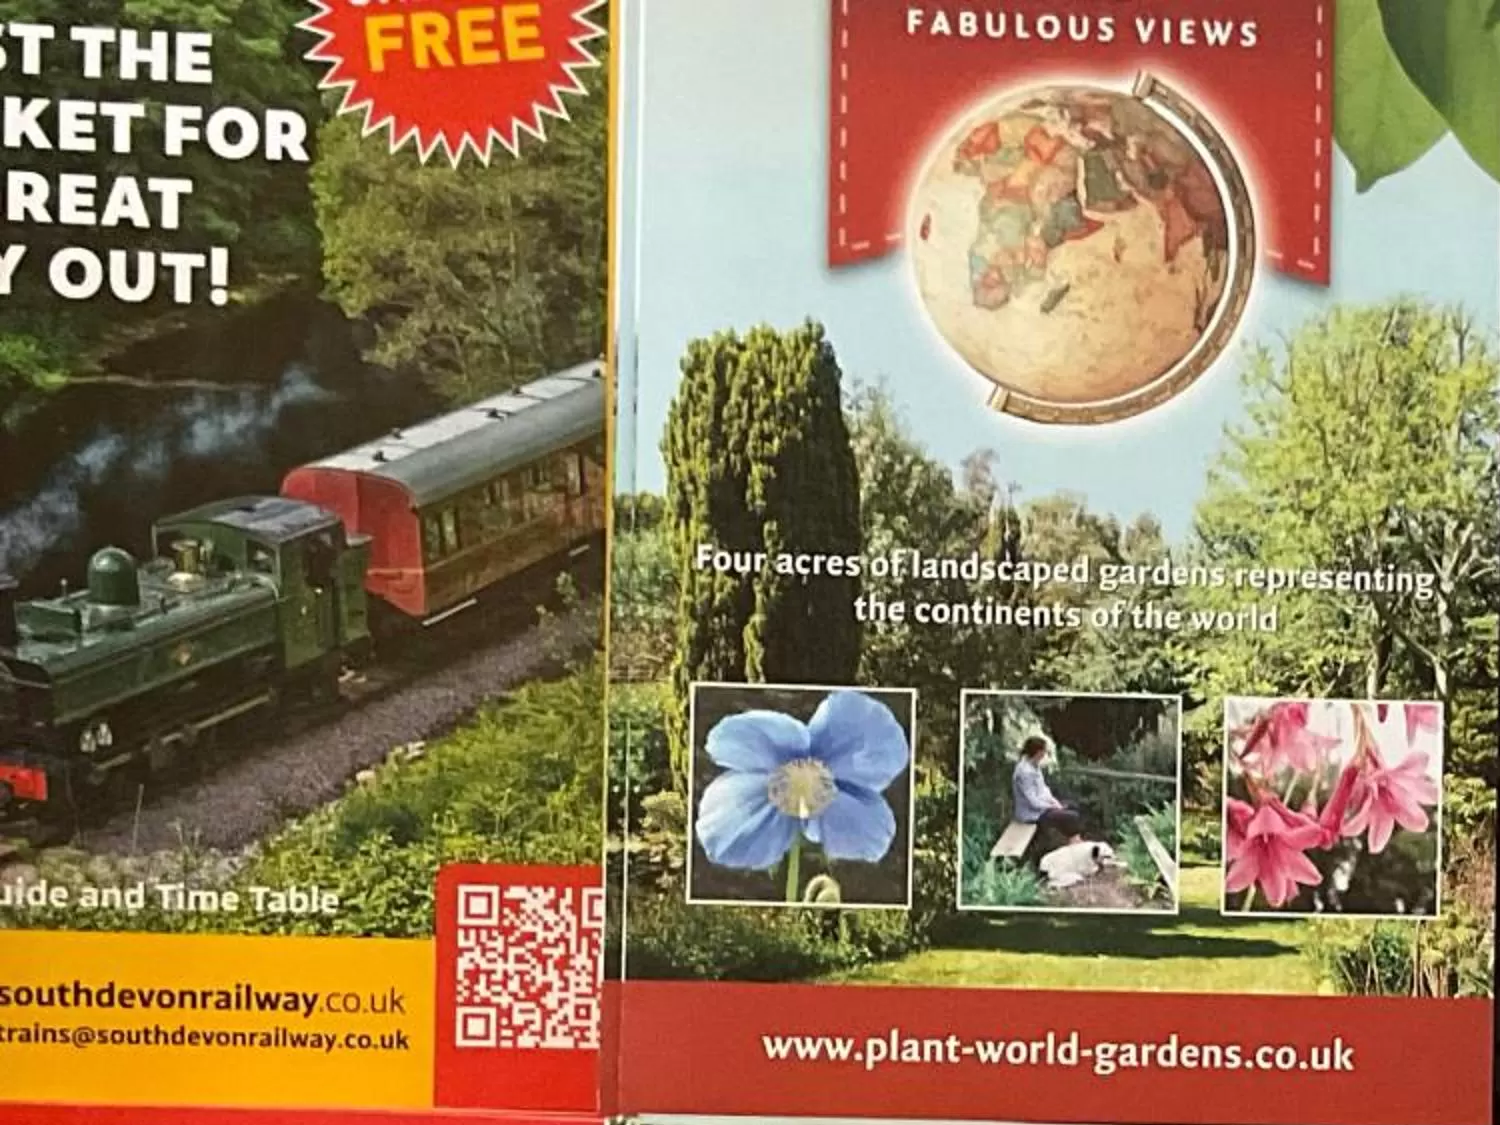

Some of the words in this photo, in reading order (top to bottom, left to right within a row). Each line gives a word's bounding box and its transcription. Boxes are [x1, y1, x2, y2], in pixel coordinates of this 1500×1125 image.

[0, 23, 54, 75] T
[71, 26, 213, 83] THE
[365, 3, 545, 72] FREE
[906, 9, 1115, 42] FABULOUS
[1136, 19, 1259, 47] VIEWS
[4, 96, 145, 153] KET
[165, 105, 310, 161] FOR
[7, 170, 193, 229] REAT
[48, 246, 229, 306] OUT!
[696, 544, 766, 572] Four
[775, 552, 860, 577] acres
[871, 549, 910, 578] of
[913, 551, 1090, 590] landscaped
[1099, 558, 1225, 591] gardens
[1235, 564, 1436, 600] representing
[855, 594, 904, 622] the
[915, 599, 1081, 628] continents
[1091, 602, 1126, 629] of
[1132, 601, 1180, 630] the
[1190, 605, 1278, 633] world
[80, 880, 144, 909] and
[156, 883, 239, 912] Time
[249, 886, 340, 914] Table
[0, 980, 407, 1018] southdevonrailway.co.uk
[762, 1029, 1354, 1076] www.plant-world-gardens.co.uk
